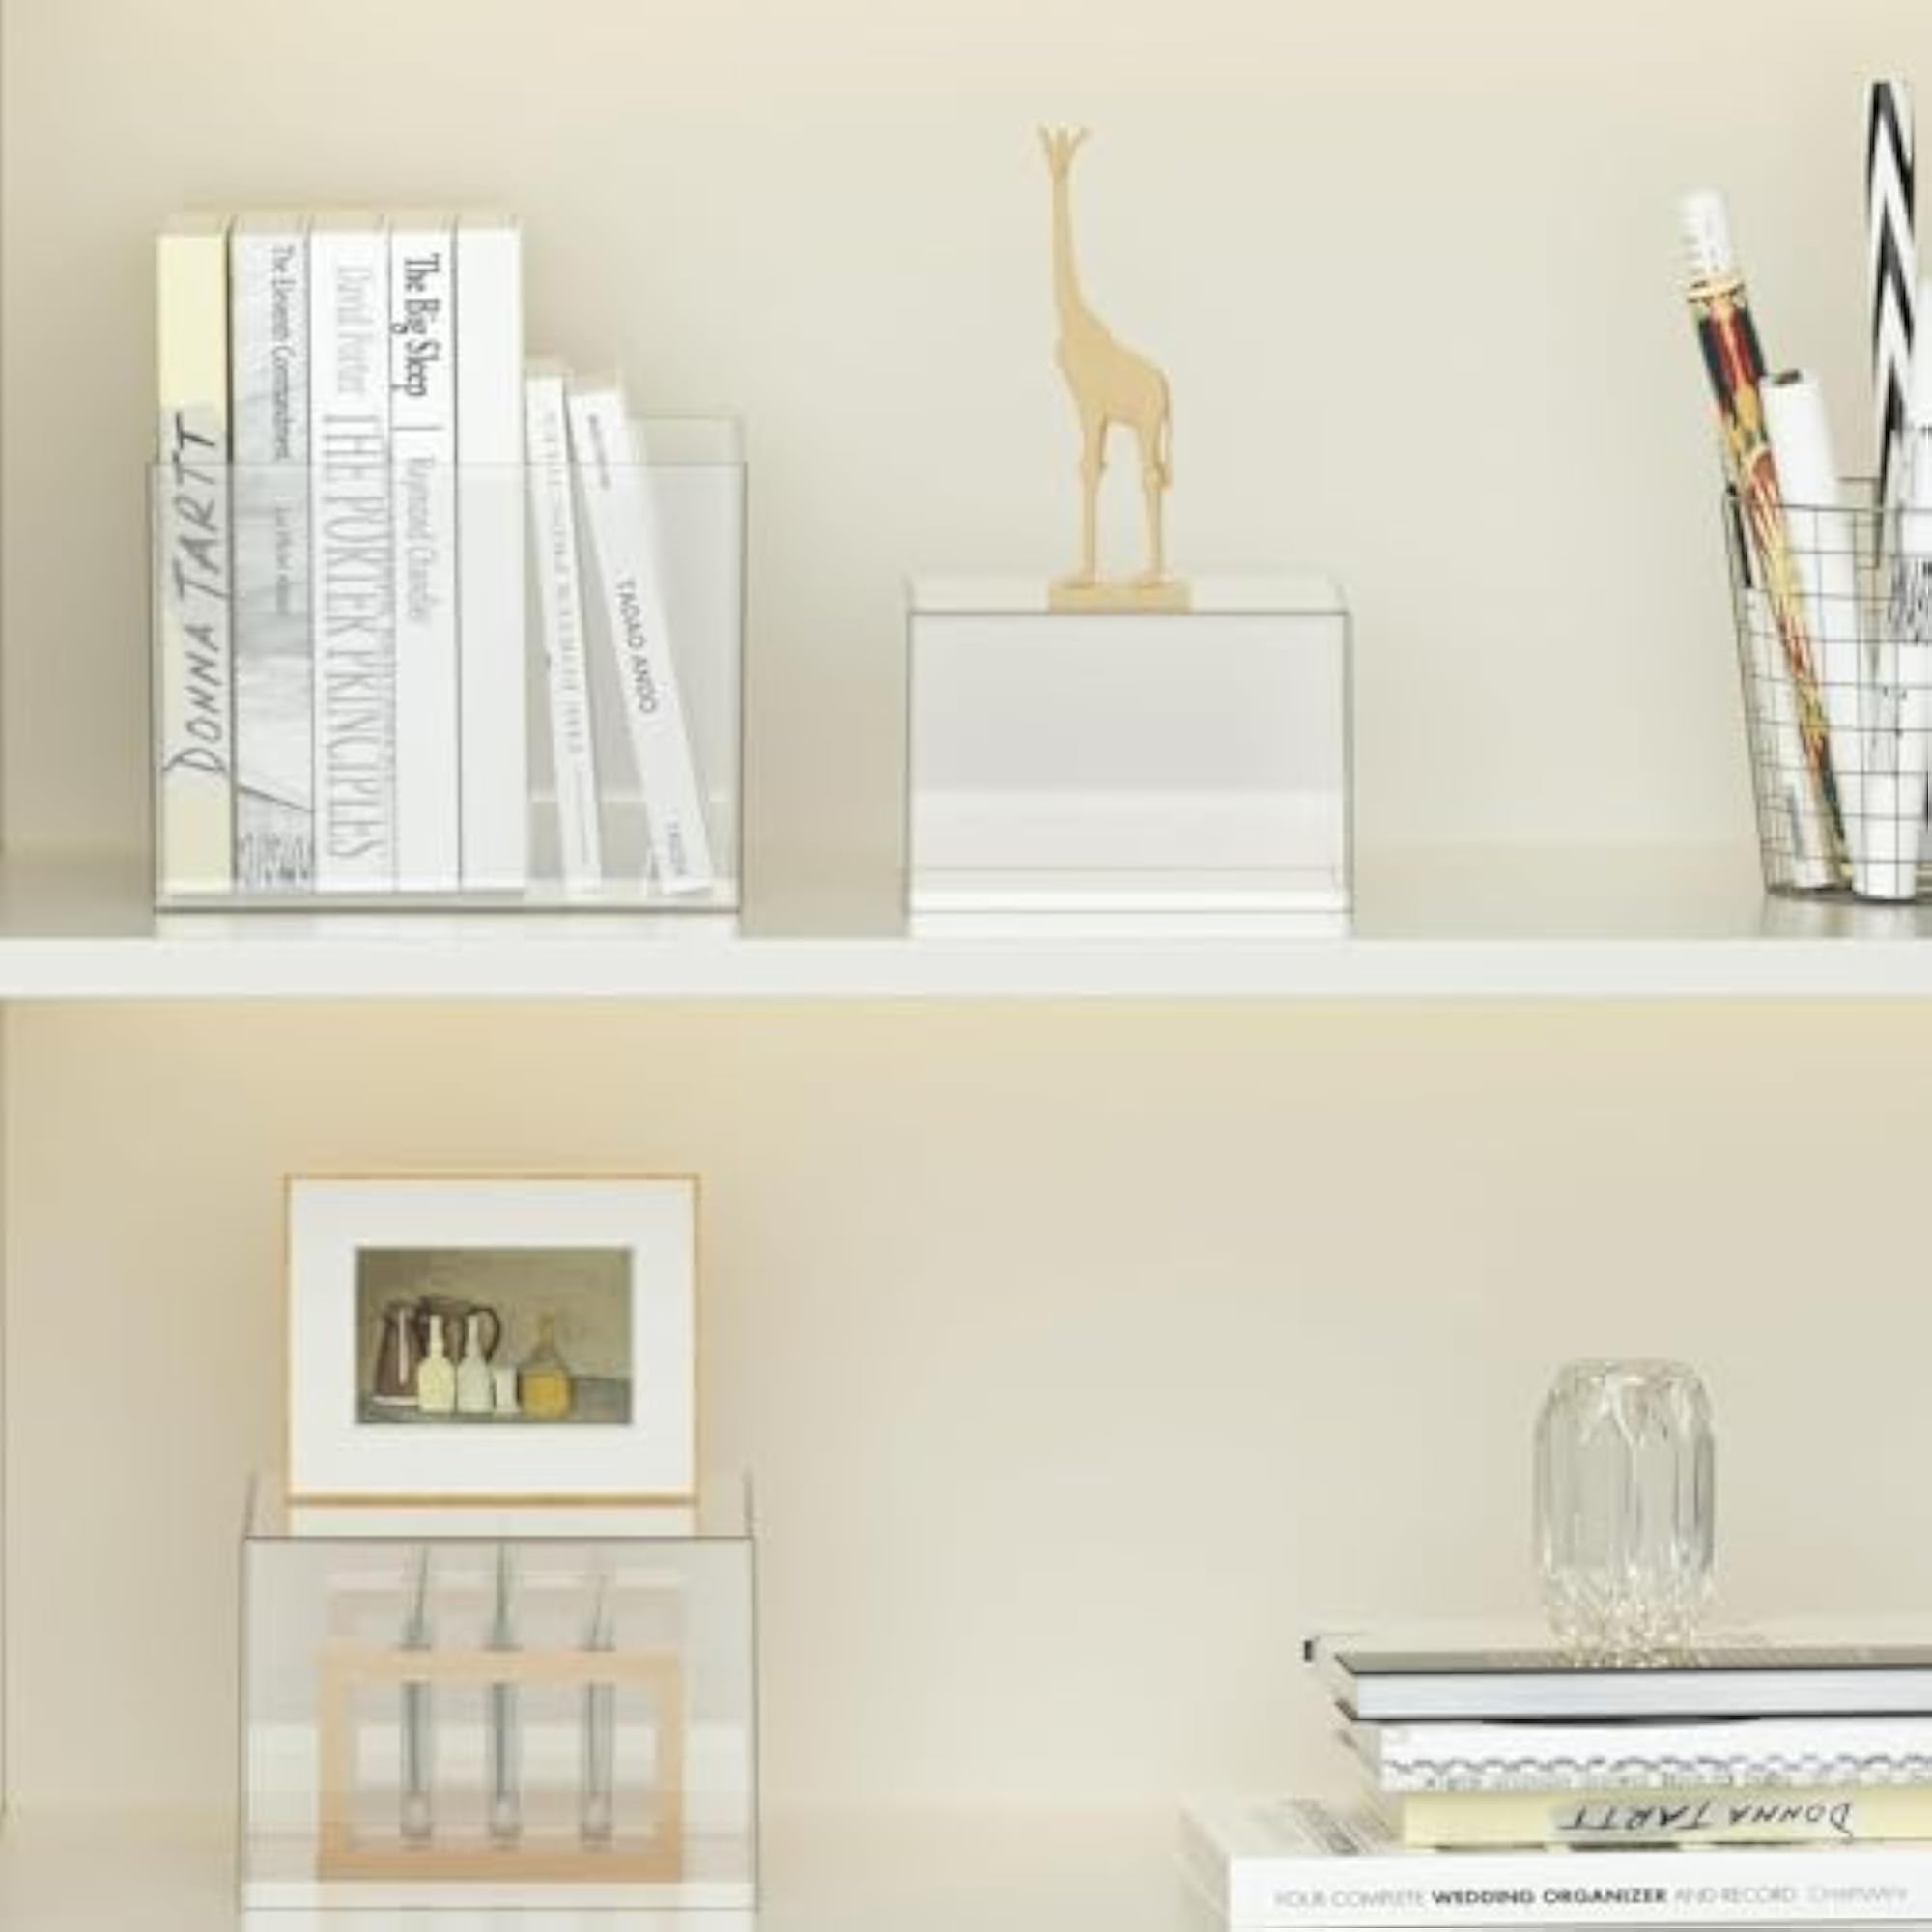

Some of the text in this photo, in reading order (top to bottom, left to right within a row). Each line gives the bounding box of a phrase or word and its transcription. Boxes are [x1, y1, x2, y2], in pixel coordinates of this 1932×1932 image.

[390, 253, 441, 397] The Big Sleep
[160, 411, 230, 773] DONNA TARTT
[323, 412, 389, 859] THE PORTER PRINCIPLES
[615, 579, 660, 714] TADAO ANDO
[1557, 1799, 1855, 1838] DONNA TARTT
[1273, 1889, 1325, 1908] YOUR
[1330, 1889, 1425, 1908] COMPLETE
[1431, 1889, 1536, 1906] WEDDING
[1543, 1887, 1667, 1905] ORGANIZER
[1674, 1887, 1719, 1904] AND
[1720, 1886, 1797, 1904] RECORD
